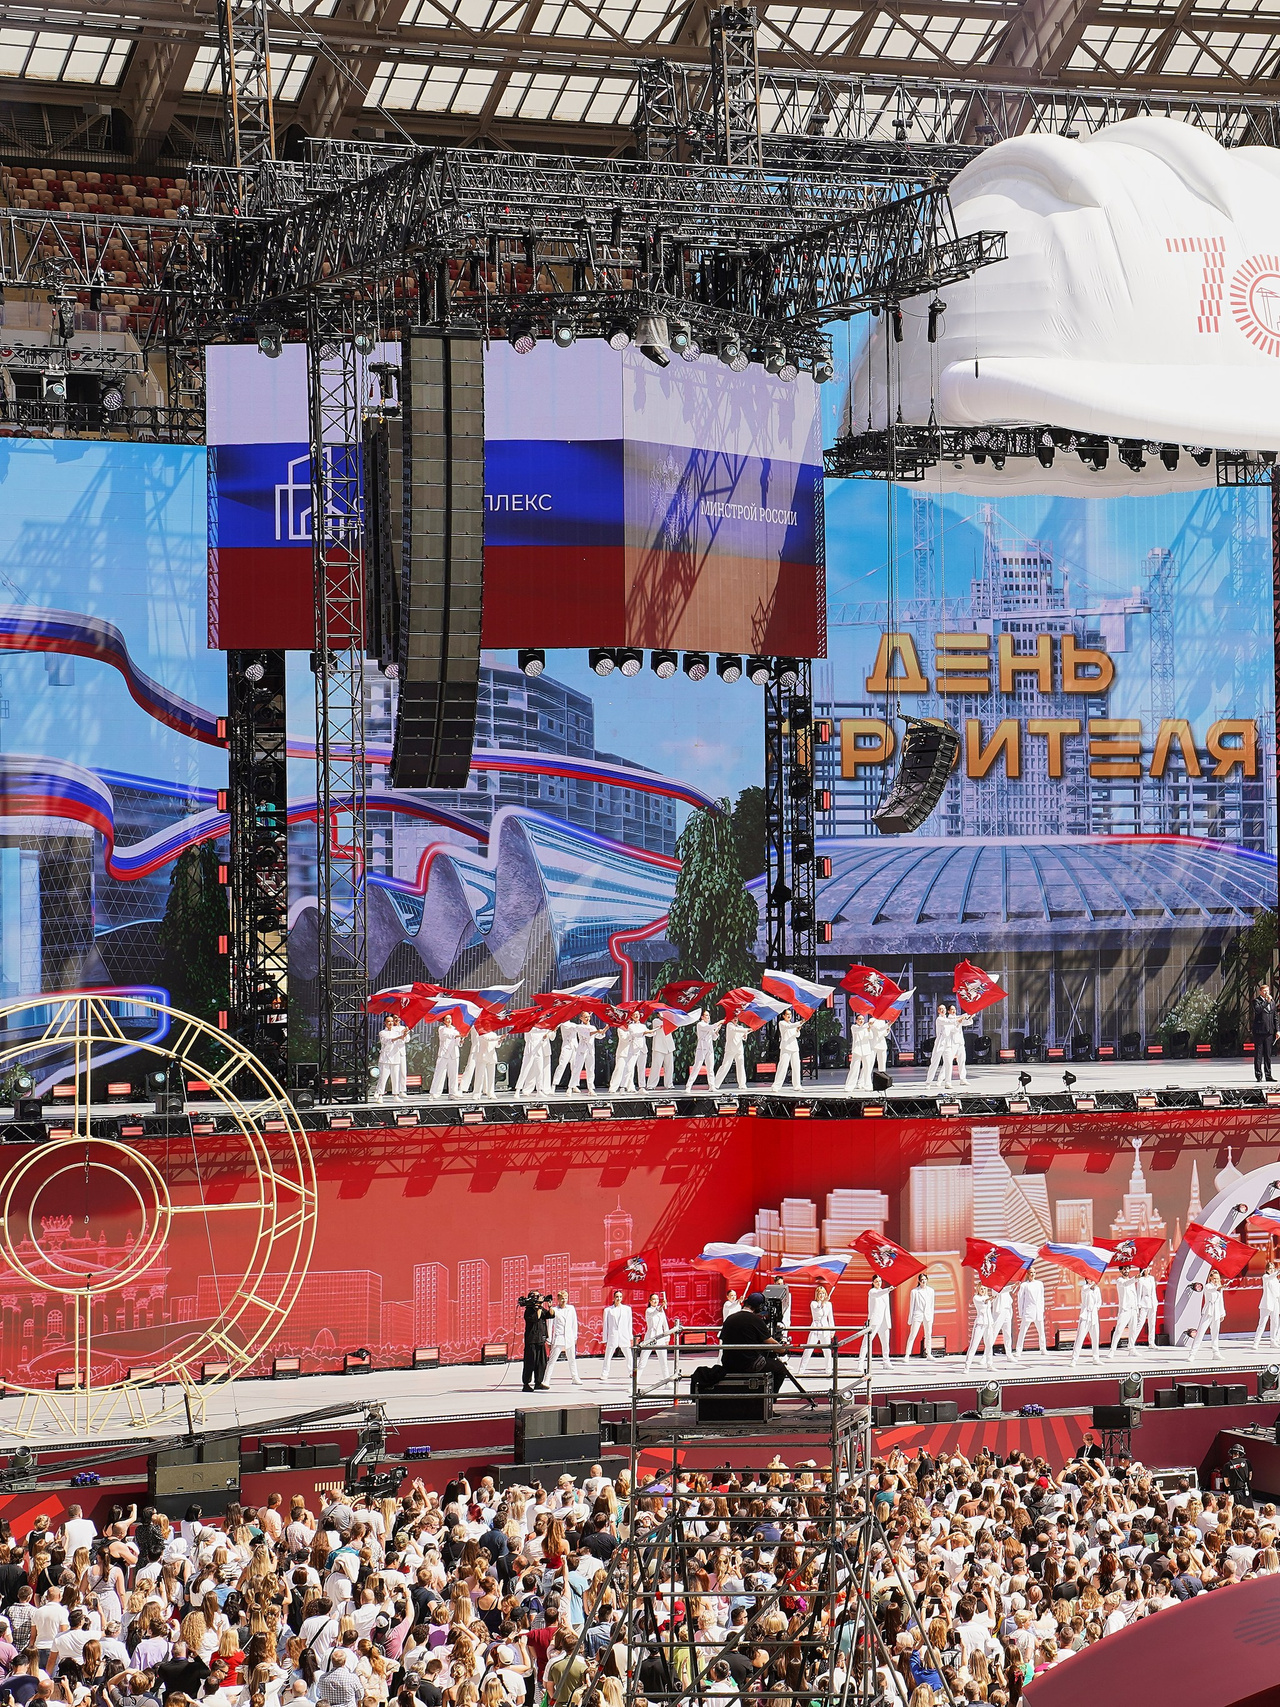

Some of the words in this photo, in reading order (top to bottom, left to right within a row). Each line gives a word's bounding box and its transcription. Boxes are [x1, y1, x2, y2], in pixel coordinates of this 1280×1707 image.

[701, 500, 757, 521] МИНСТРОЙ
[760, 507, 798, 526] РОССИИ
[866, 632, 1116, 694] ДЕНЬ
